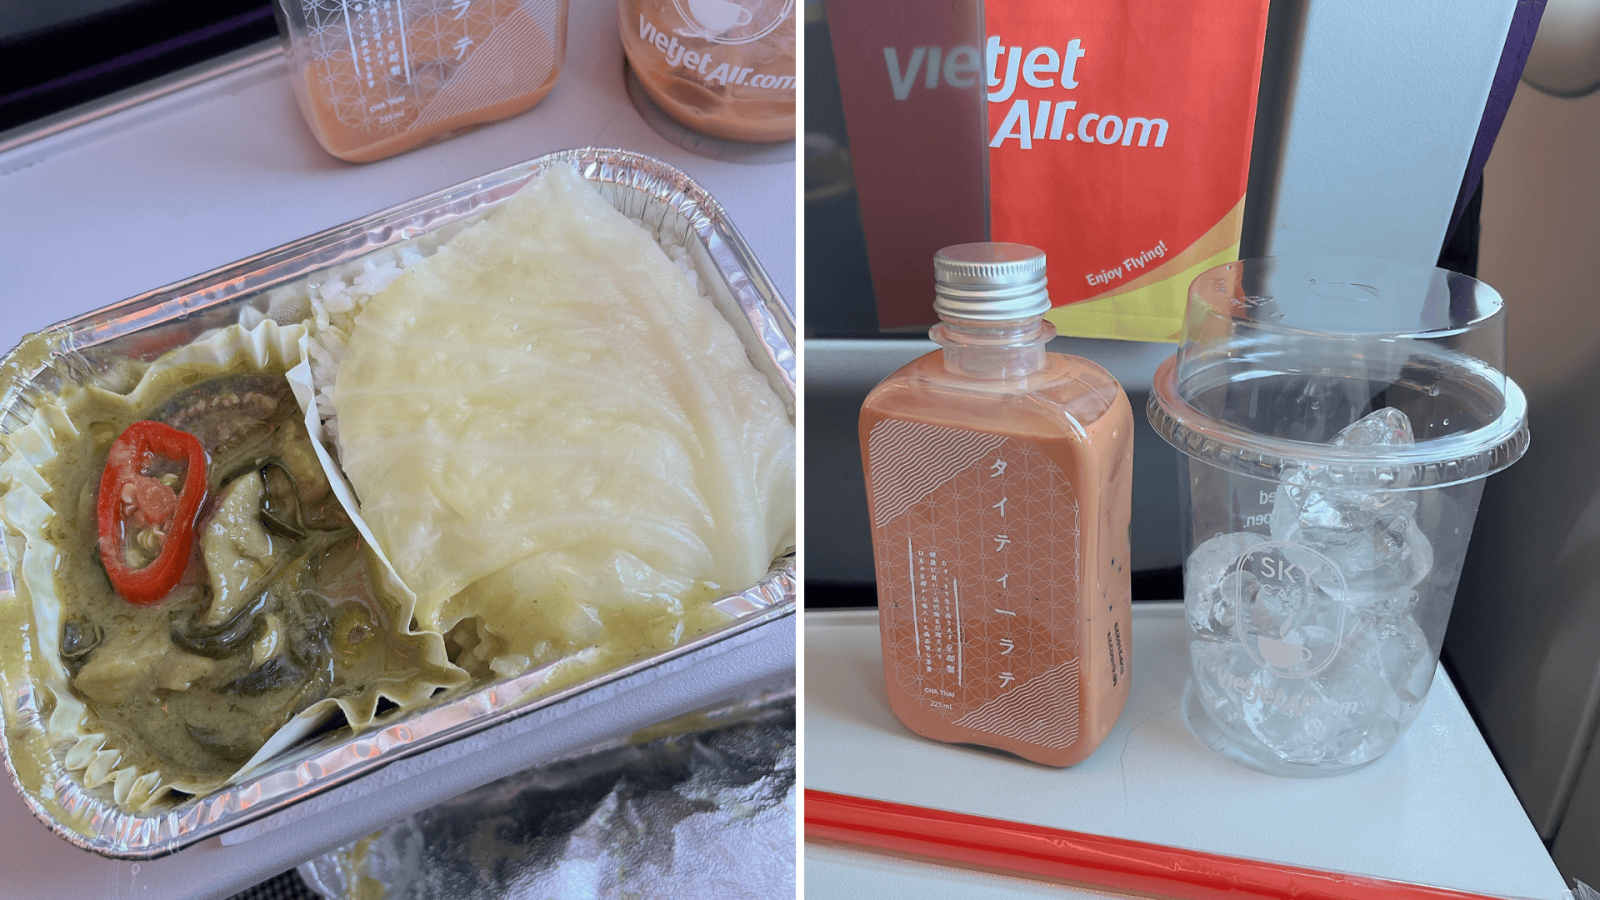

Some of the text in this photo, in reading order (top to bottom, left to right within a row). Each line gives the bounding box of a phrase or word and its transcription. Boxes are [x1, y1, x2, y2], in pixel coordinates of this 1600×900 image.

[369, 103, 386, 113] CHA
[988, 99, 1169, 150] Air.com
[1085, 240, 1168, 286] Enjoy Flying!
[990, 459, 1017, 688] タイティーラテ
[1260, 556, 1321, 586] SKY
[924, 686, 955, 698] CHA THAI
[930, 699, 942, 708] 225
